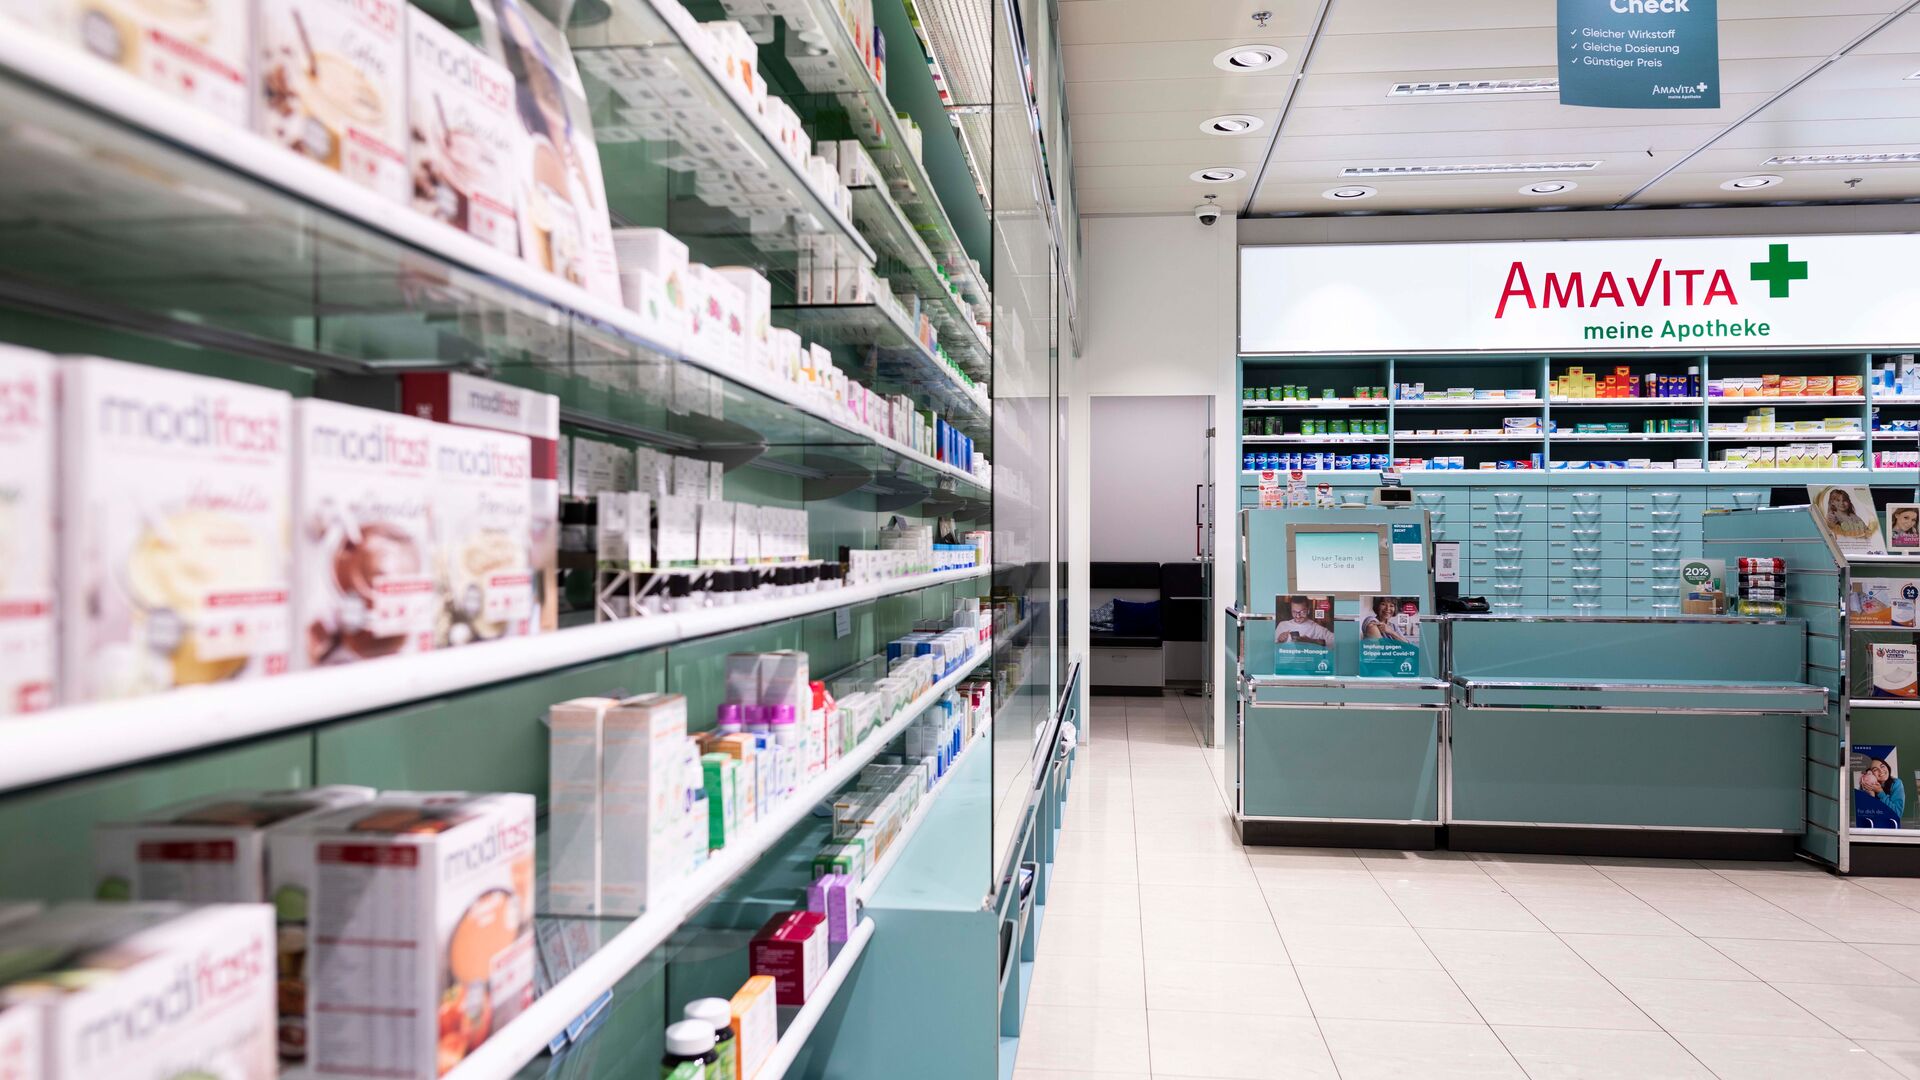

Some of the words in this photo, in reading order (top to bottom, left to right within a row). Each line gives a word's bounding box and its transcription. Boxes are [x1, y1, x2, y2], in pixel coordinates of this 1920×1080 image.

[1582, 28, 1625, 39] Gleicher
[1628, 29, 1676, 39] Wirkstoff
[1582, 42, 1622, 53] Gleiche
[1625, 44, 1680, 55] Dosierung
[1583, 56, 1634, 69] Günstiger
[1637, 58, 1663, 68] Preis
[1652, 84, 1695, 96] AMAVITA
[1494, 259, 1738, 319] AMAVITA
[1584, 321, 1653, 340] meine
[1660, 318, 1771, 342] Apotheke
[1685, 567, 1709, 576] 20%
[1279, 648, 1329, 656] Rezepte-Manager
[1363, 643, 1385, 651] Impfung
